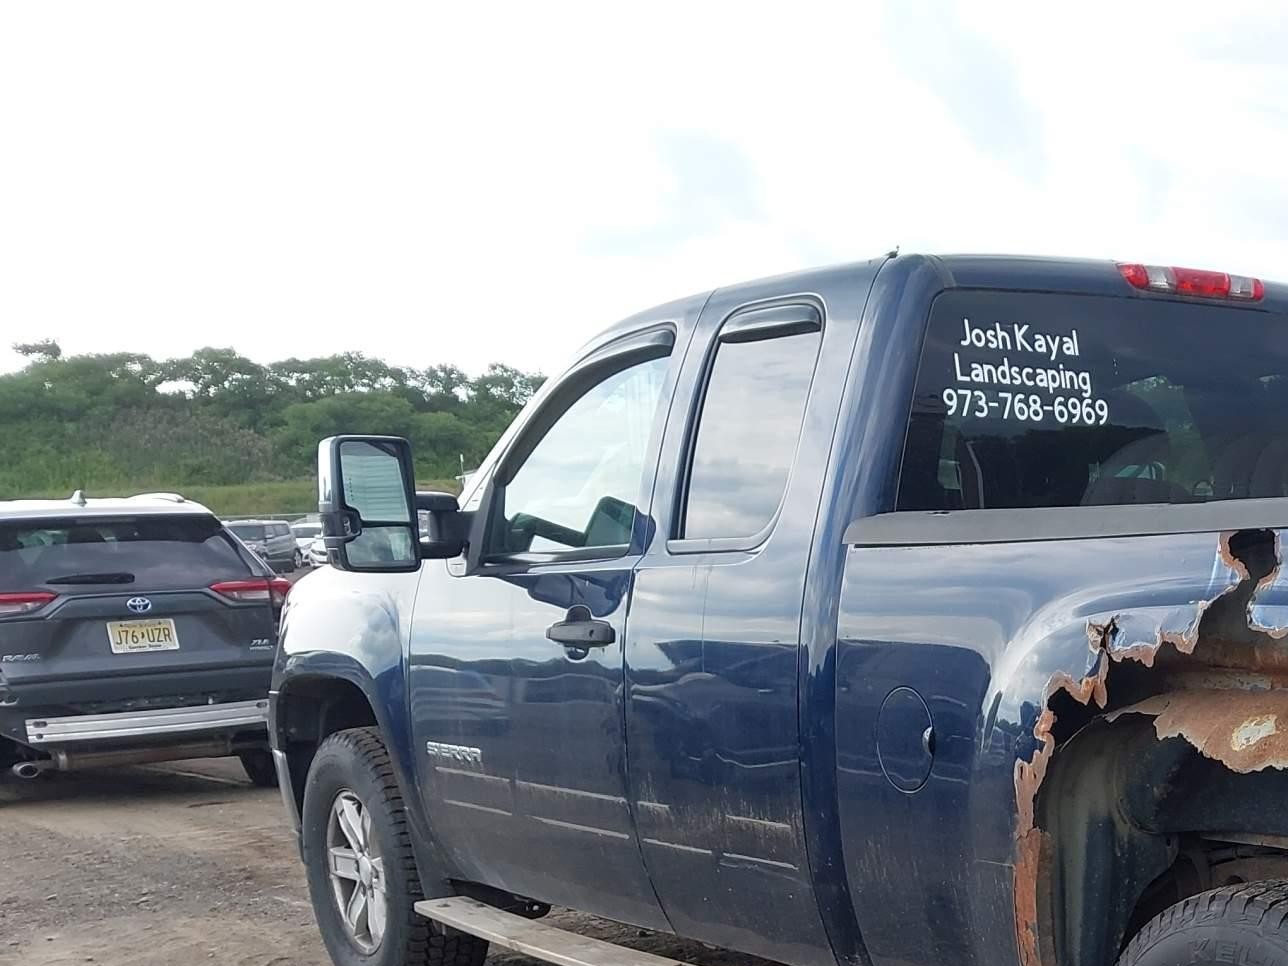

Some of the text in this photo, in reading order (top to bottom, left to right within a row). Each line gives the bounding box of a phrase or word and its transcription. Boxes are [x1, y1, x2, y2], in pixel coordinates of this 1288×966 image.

[960, 318, 1080, 361] Josh Kayal
[953, 352, 1092, 398] Landscaping
[942, 388, 1109, 425] 973-768-6969
[425, 741, 482, 762] SIERRA
